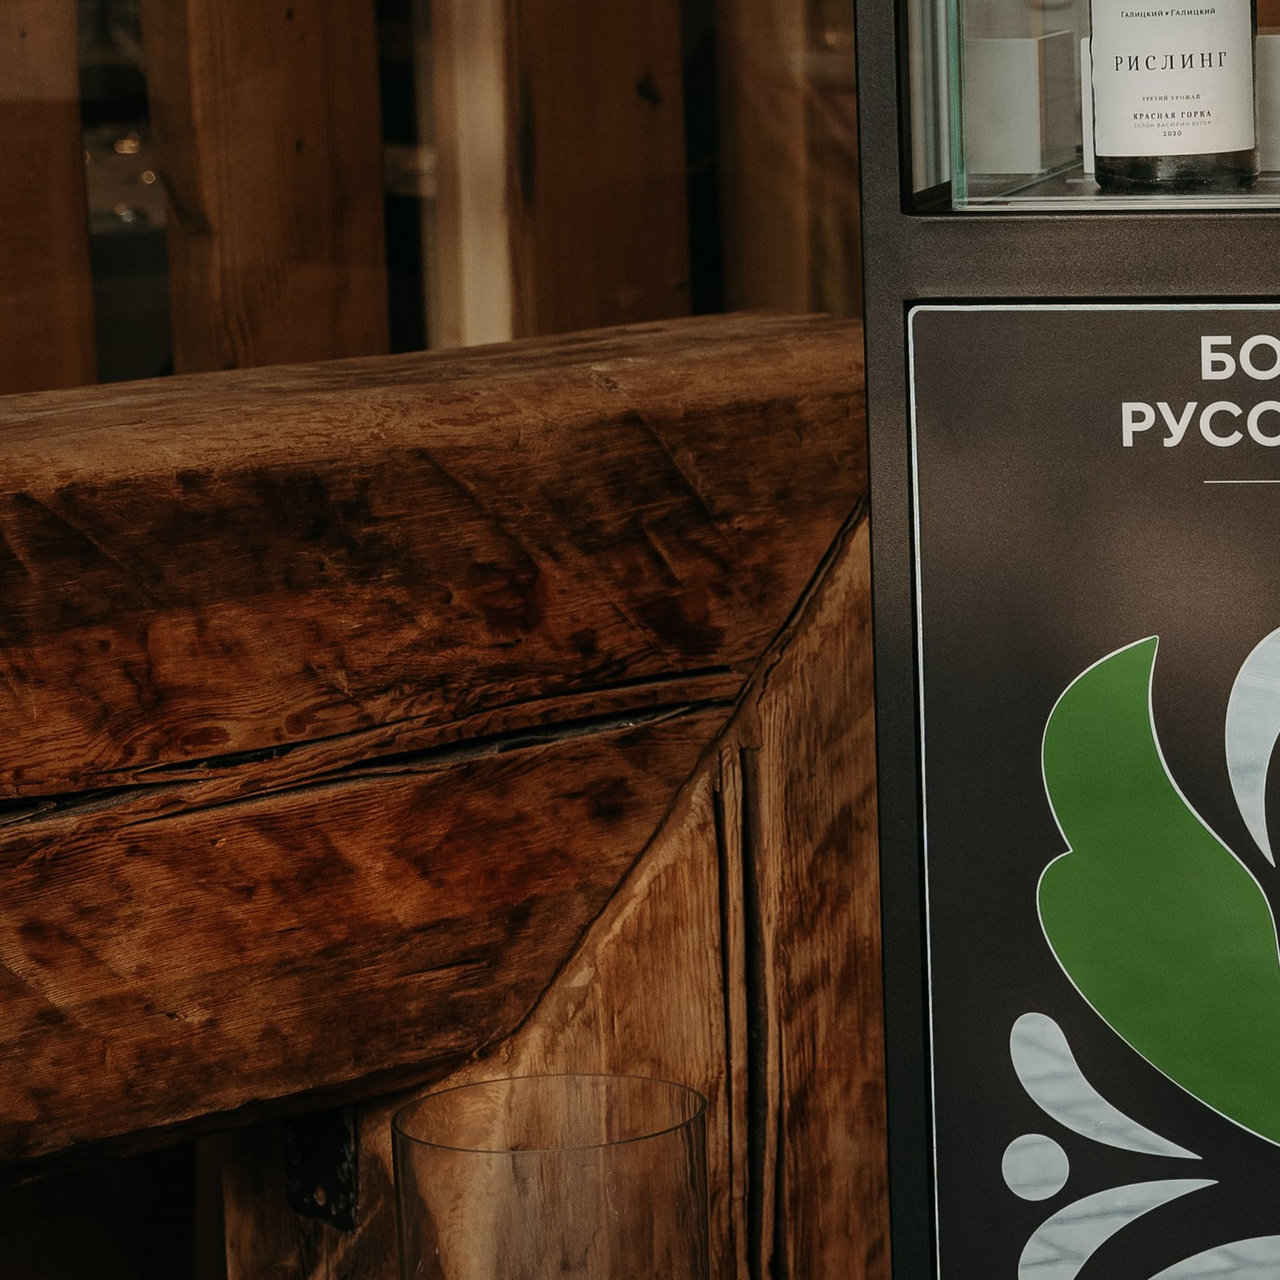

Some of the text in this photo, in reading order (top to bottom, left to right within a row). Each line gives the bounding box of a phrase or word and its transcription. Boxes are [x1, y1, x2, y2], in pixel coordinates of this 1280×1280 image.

[1114, 51, 1227, 71] РИСЛИНГ
[1133, 110, 1212, 120] КРАСНАЯ ГОРКА
